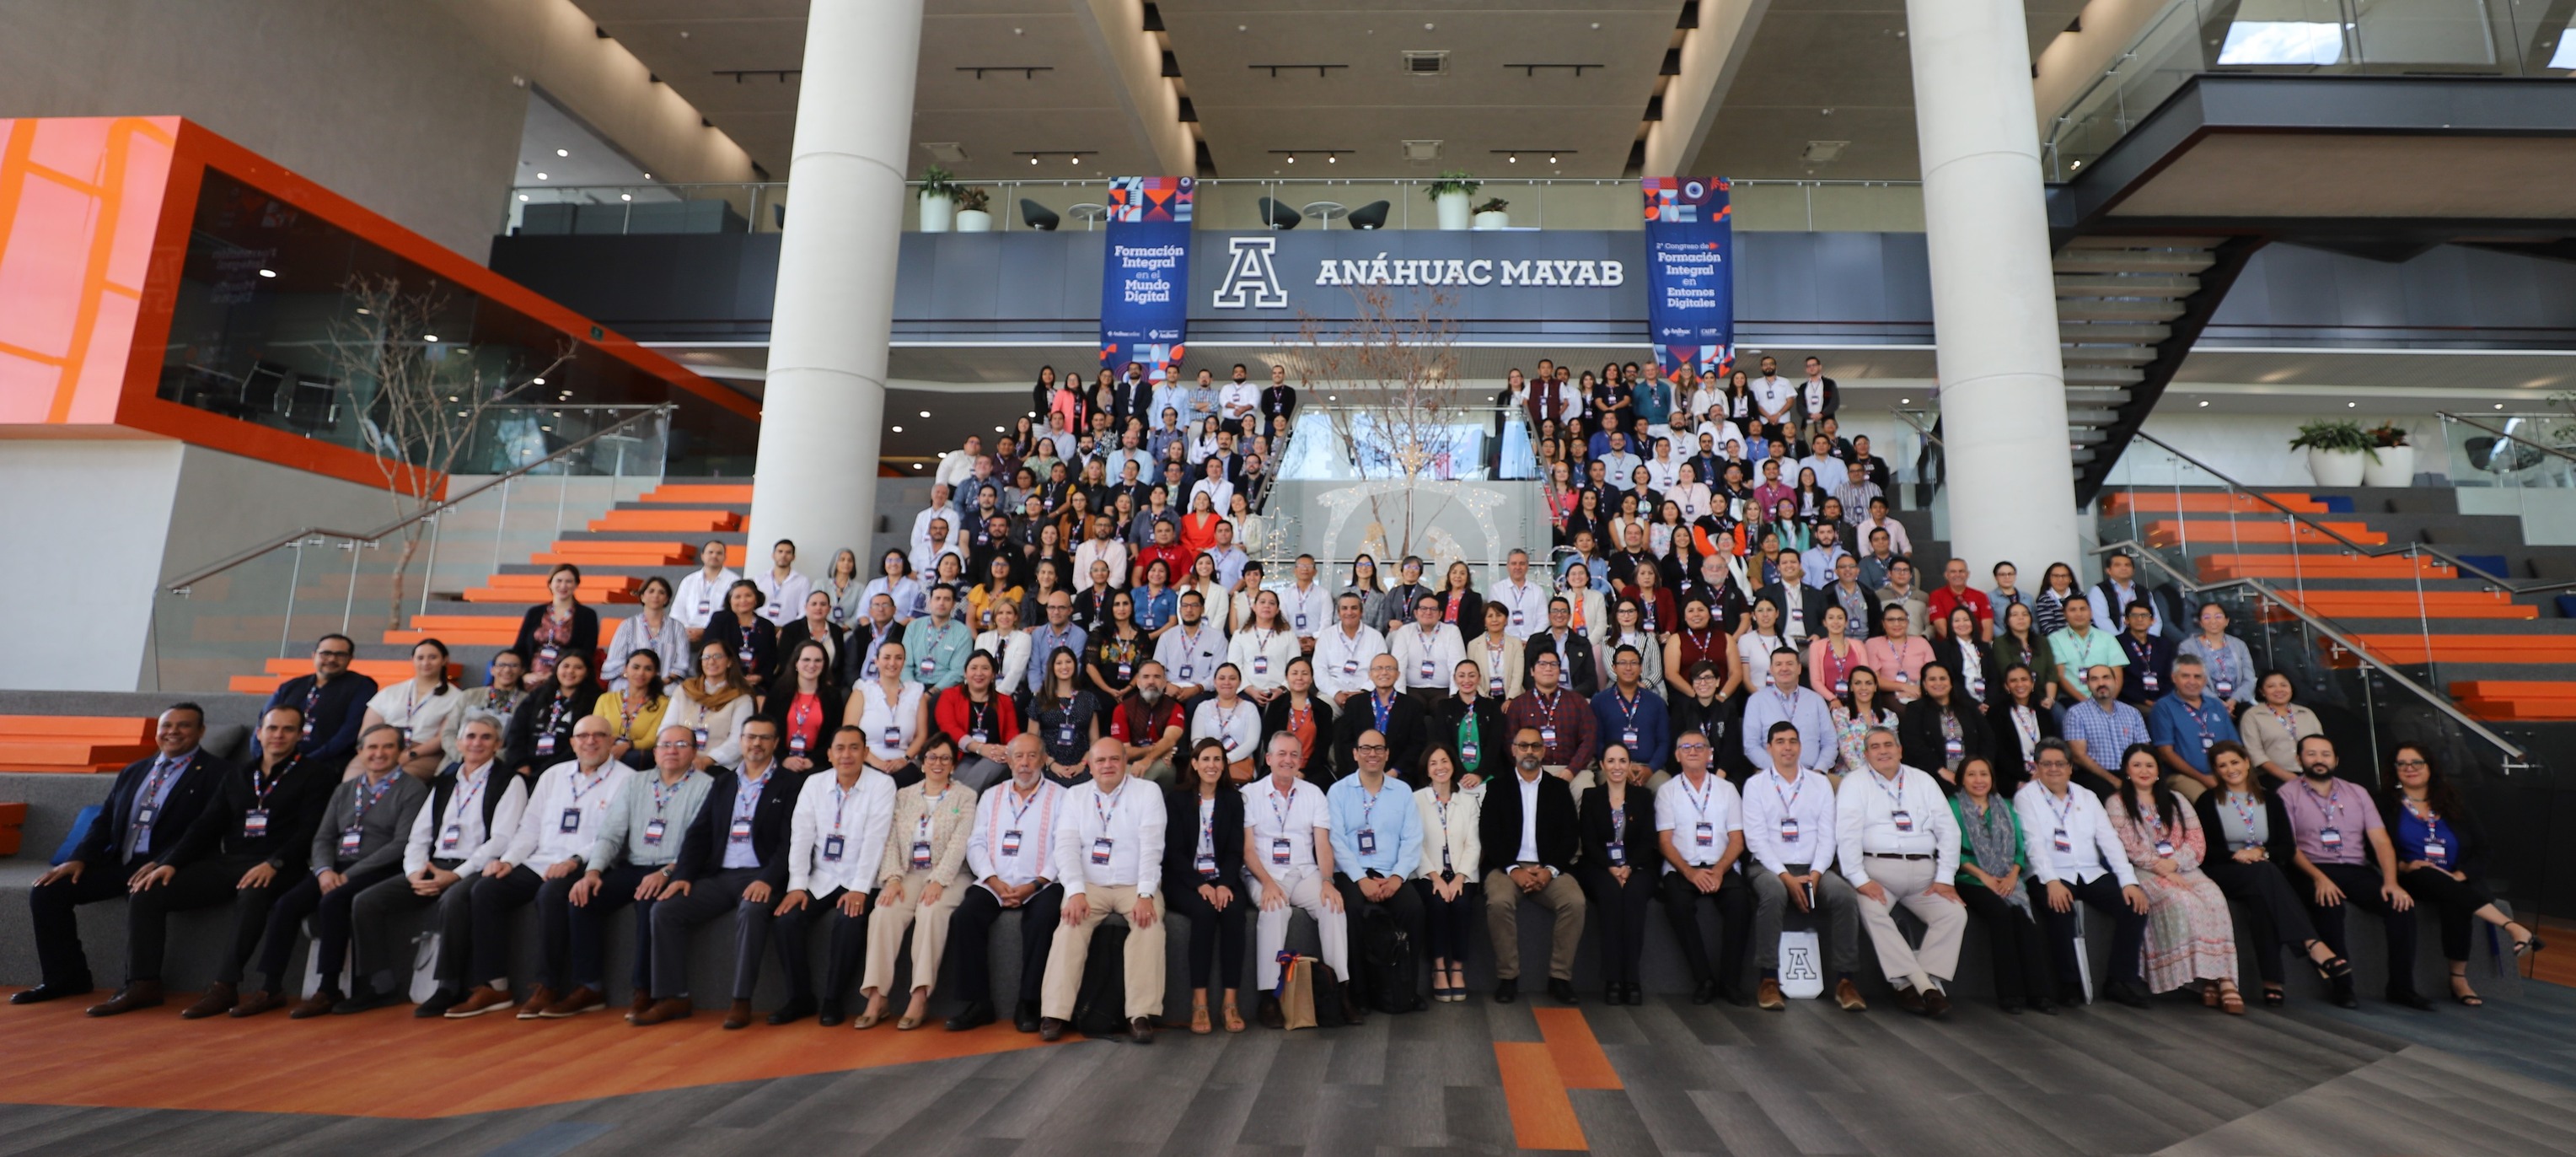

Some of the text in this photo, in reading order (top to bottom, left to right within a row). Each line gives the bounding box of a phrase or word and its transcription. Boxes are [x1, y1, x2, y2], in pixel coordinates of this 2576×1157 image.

[1114, 245, 1184, 256] Formación
[1665, 242, 1699, 250] Congreso
[1122, 256, 1176, 270] Integral
[1657, 251, 1721, 262] Formación
[1151, 270, 1161, 279] el
[1213, 236, 1288, 308] A
[1315, 252, 1624, 286] ANÁHUAC MAYAB
[1666, 264, 1714, 277] Integral
[1124, 278, 1171, 291] Mundo
[1124, 290, 1170, 304] Digital
[1666, 287, 1715, 297] Entornos
[1667, 298, 1716, 309] Digitales
[1786, 948, 1817, 980] A
